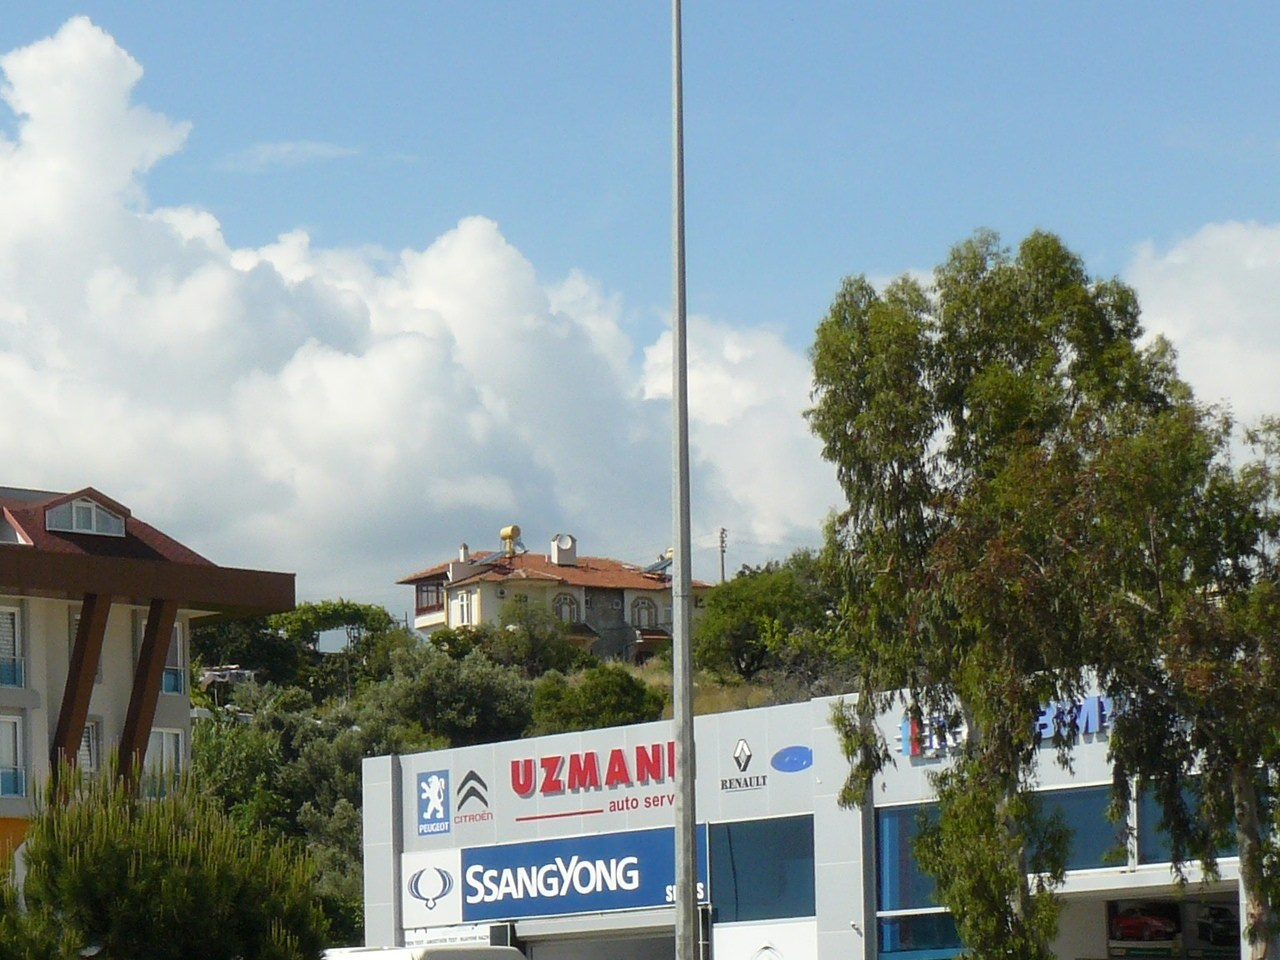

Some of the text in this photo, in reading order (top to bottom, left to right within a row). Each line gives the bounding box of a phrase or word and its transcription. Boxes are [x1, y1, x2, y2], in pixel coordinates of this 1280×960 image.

[721, 775, 767, 790] RENAULT
[609, 794, 675, 812] auto serv
[419, 822, 449, 833] PEUGEOT
